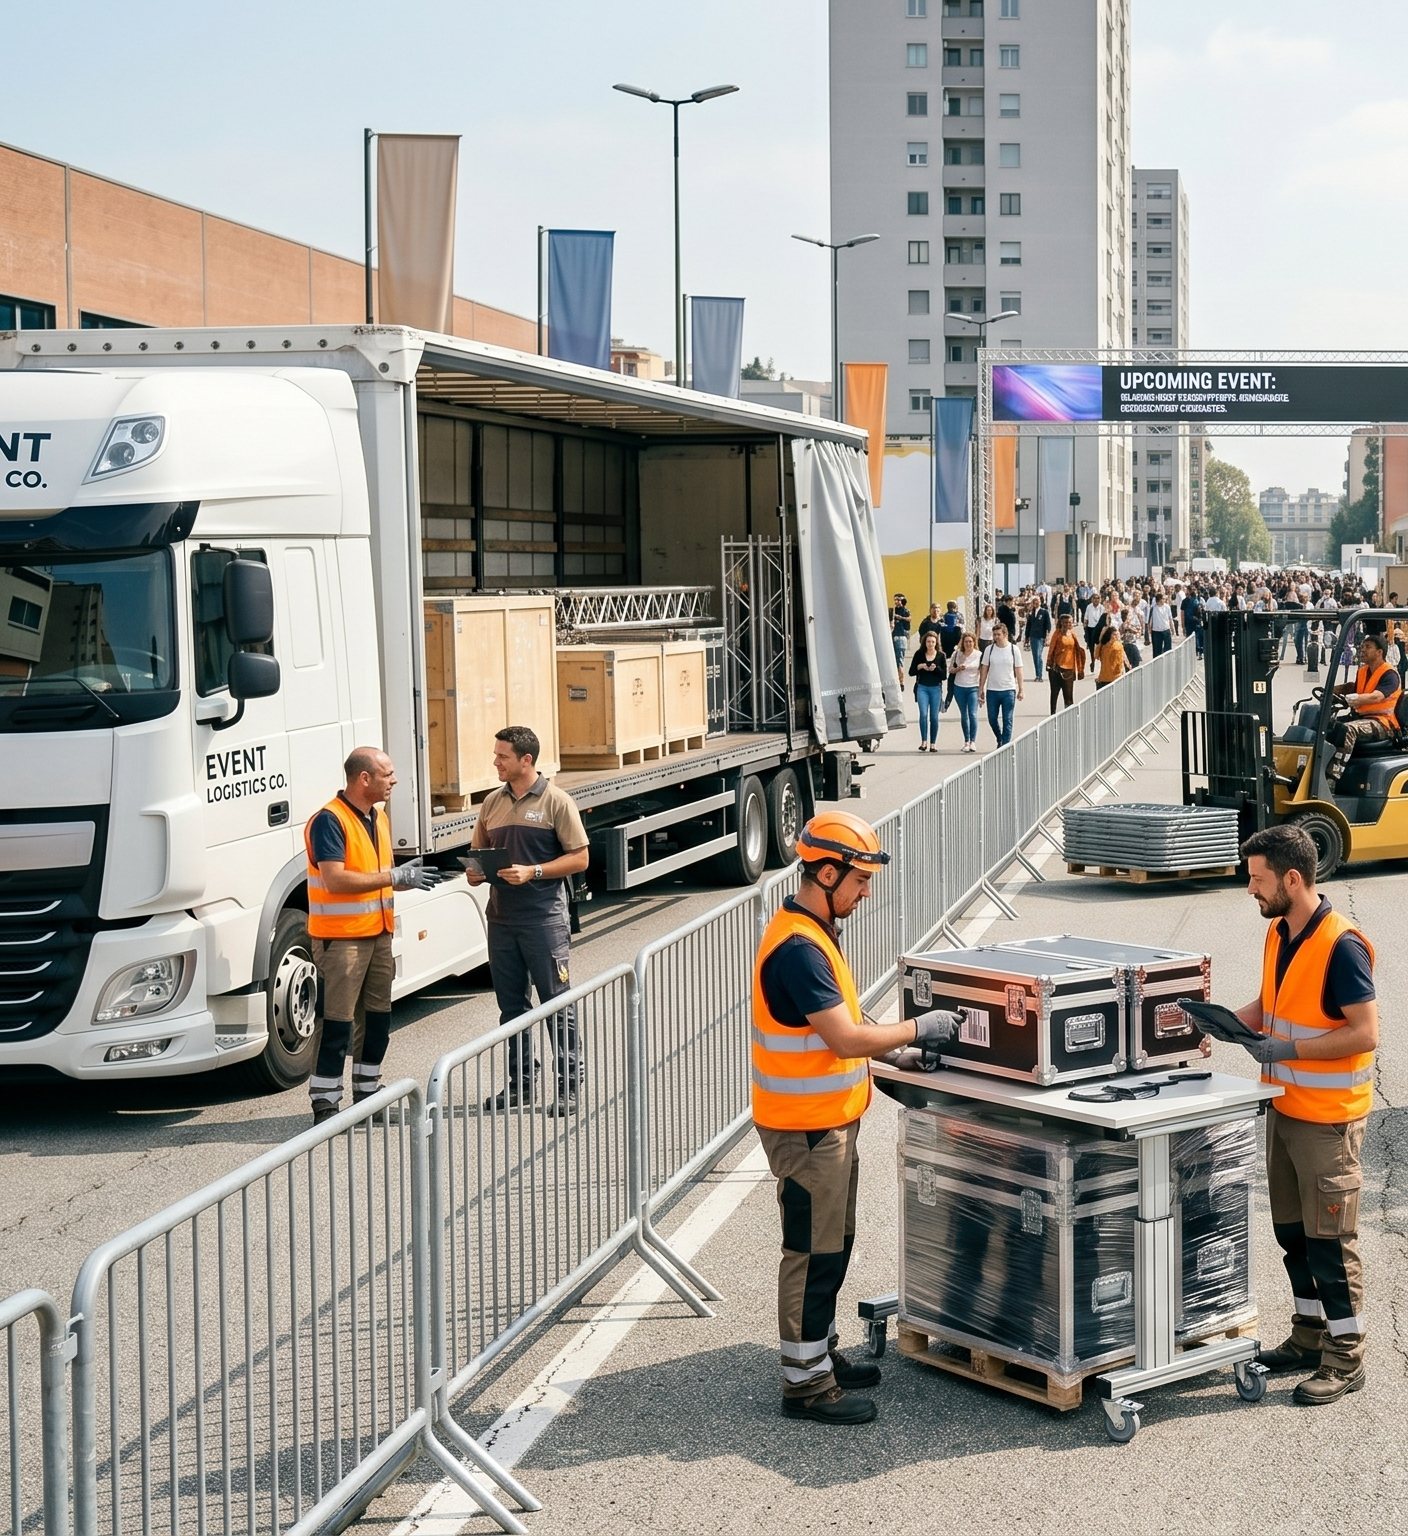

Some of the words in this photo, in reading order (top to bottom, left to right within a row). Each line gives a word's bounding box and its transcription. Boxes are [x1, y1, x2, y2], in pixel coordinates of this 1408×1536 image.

[1120, 372, 1212, 390] UPCOMING
[1218, 372, 1276, 390] EVENT:
[5, 470, 48, 489] CO.
[206, 745, 266, 780] EVENT
[207, 777, 266, 803] LOGISTICS
[269, 773, 288, 790] CO.
